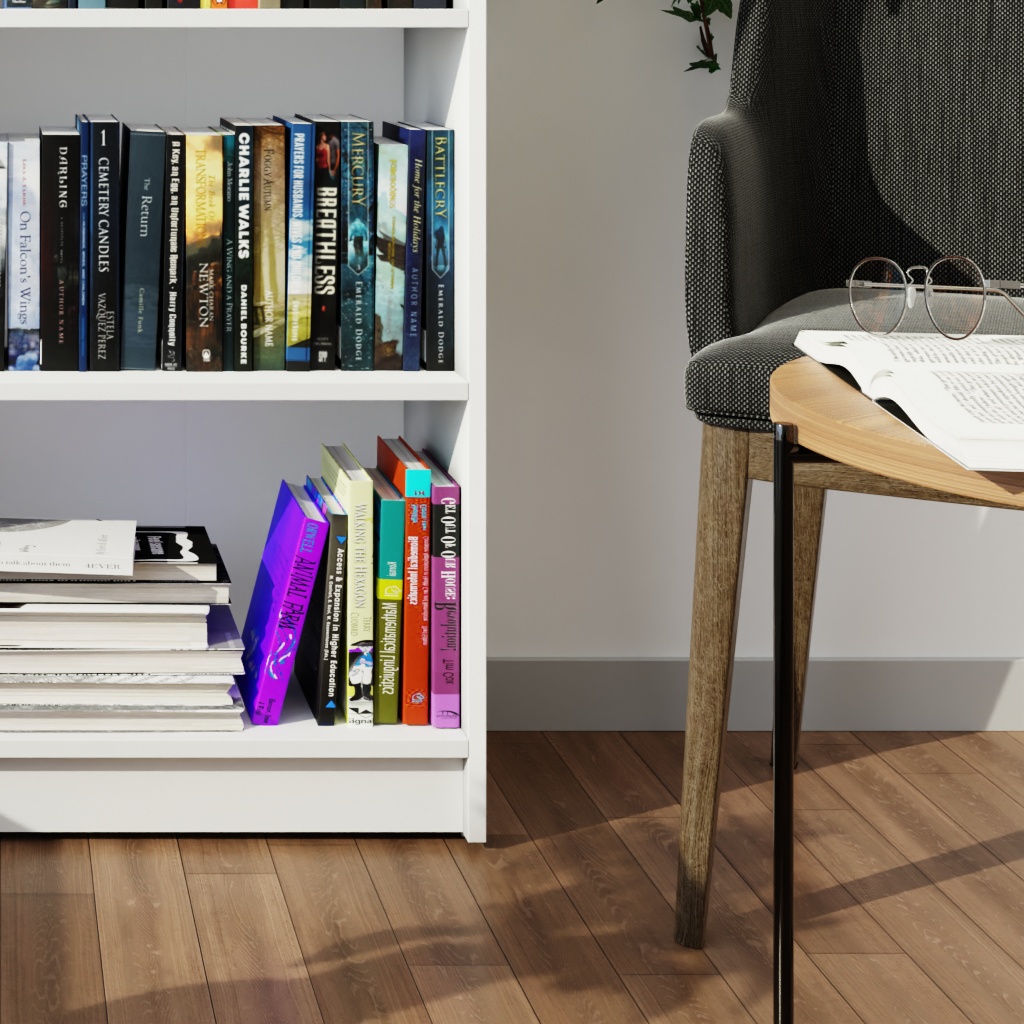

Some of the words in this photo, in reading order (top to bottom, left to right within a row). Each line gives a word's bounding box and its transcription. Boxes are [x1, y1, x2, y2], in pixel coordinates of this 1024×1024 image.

[57, 146, 68, 208] DARLING
[238, 132, 250, 201] CHARLIE
[351, 132, 366, 207] MERCURY
[414, 159, 422, 183] Home
[434, 137, 447, 218] BATTLECRY
[98, 157, 109, 216] CEMETERY
[412, 186, 422, 198] for
[20, 211, 31, 231] On
[140, 196, 153, 237] Return
[413, 201, 422, 213] the
[98, 219, 109, 272] CANDLES
[238, 204, 250, 259] WALKS
[315, 187, 338, 295] BREATHLESS
[411, 215, 422, 253] Holidays
[19, 234, 31, 283] Falcon's
[17, 287, 31, 325] Wings
[96, 292, 106, 332] VAZQUEZ
[199, 263, 209, 328] NEWTON
[355, 281, 363, 326] EMERALD
[106, 311, 114, 339] ESTELA
[98, 335, 106, 359] PEREZ
[355, 329, 363, 361] DODGE
[300, 522, 318, 553] ORWELL
[355, 504, 366, 544] WALKING
[335, 548, 344, 575] Access
[355, 546, 366, 563] THE
[287, 555, 316, 597] ANIMAL
[355, 566, 367, 608] HEXAGON
[278, 600, 304, 630] FARM
[333, 585, 343, 622] Expansion
[329, 633, 340, 658] Higher
[328, 660, 338, 697] Education
